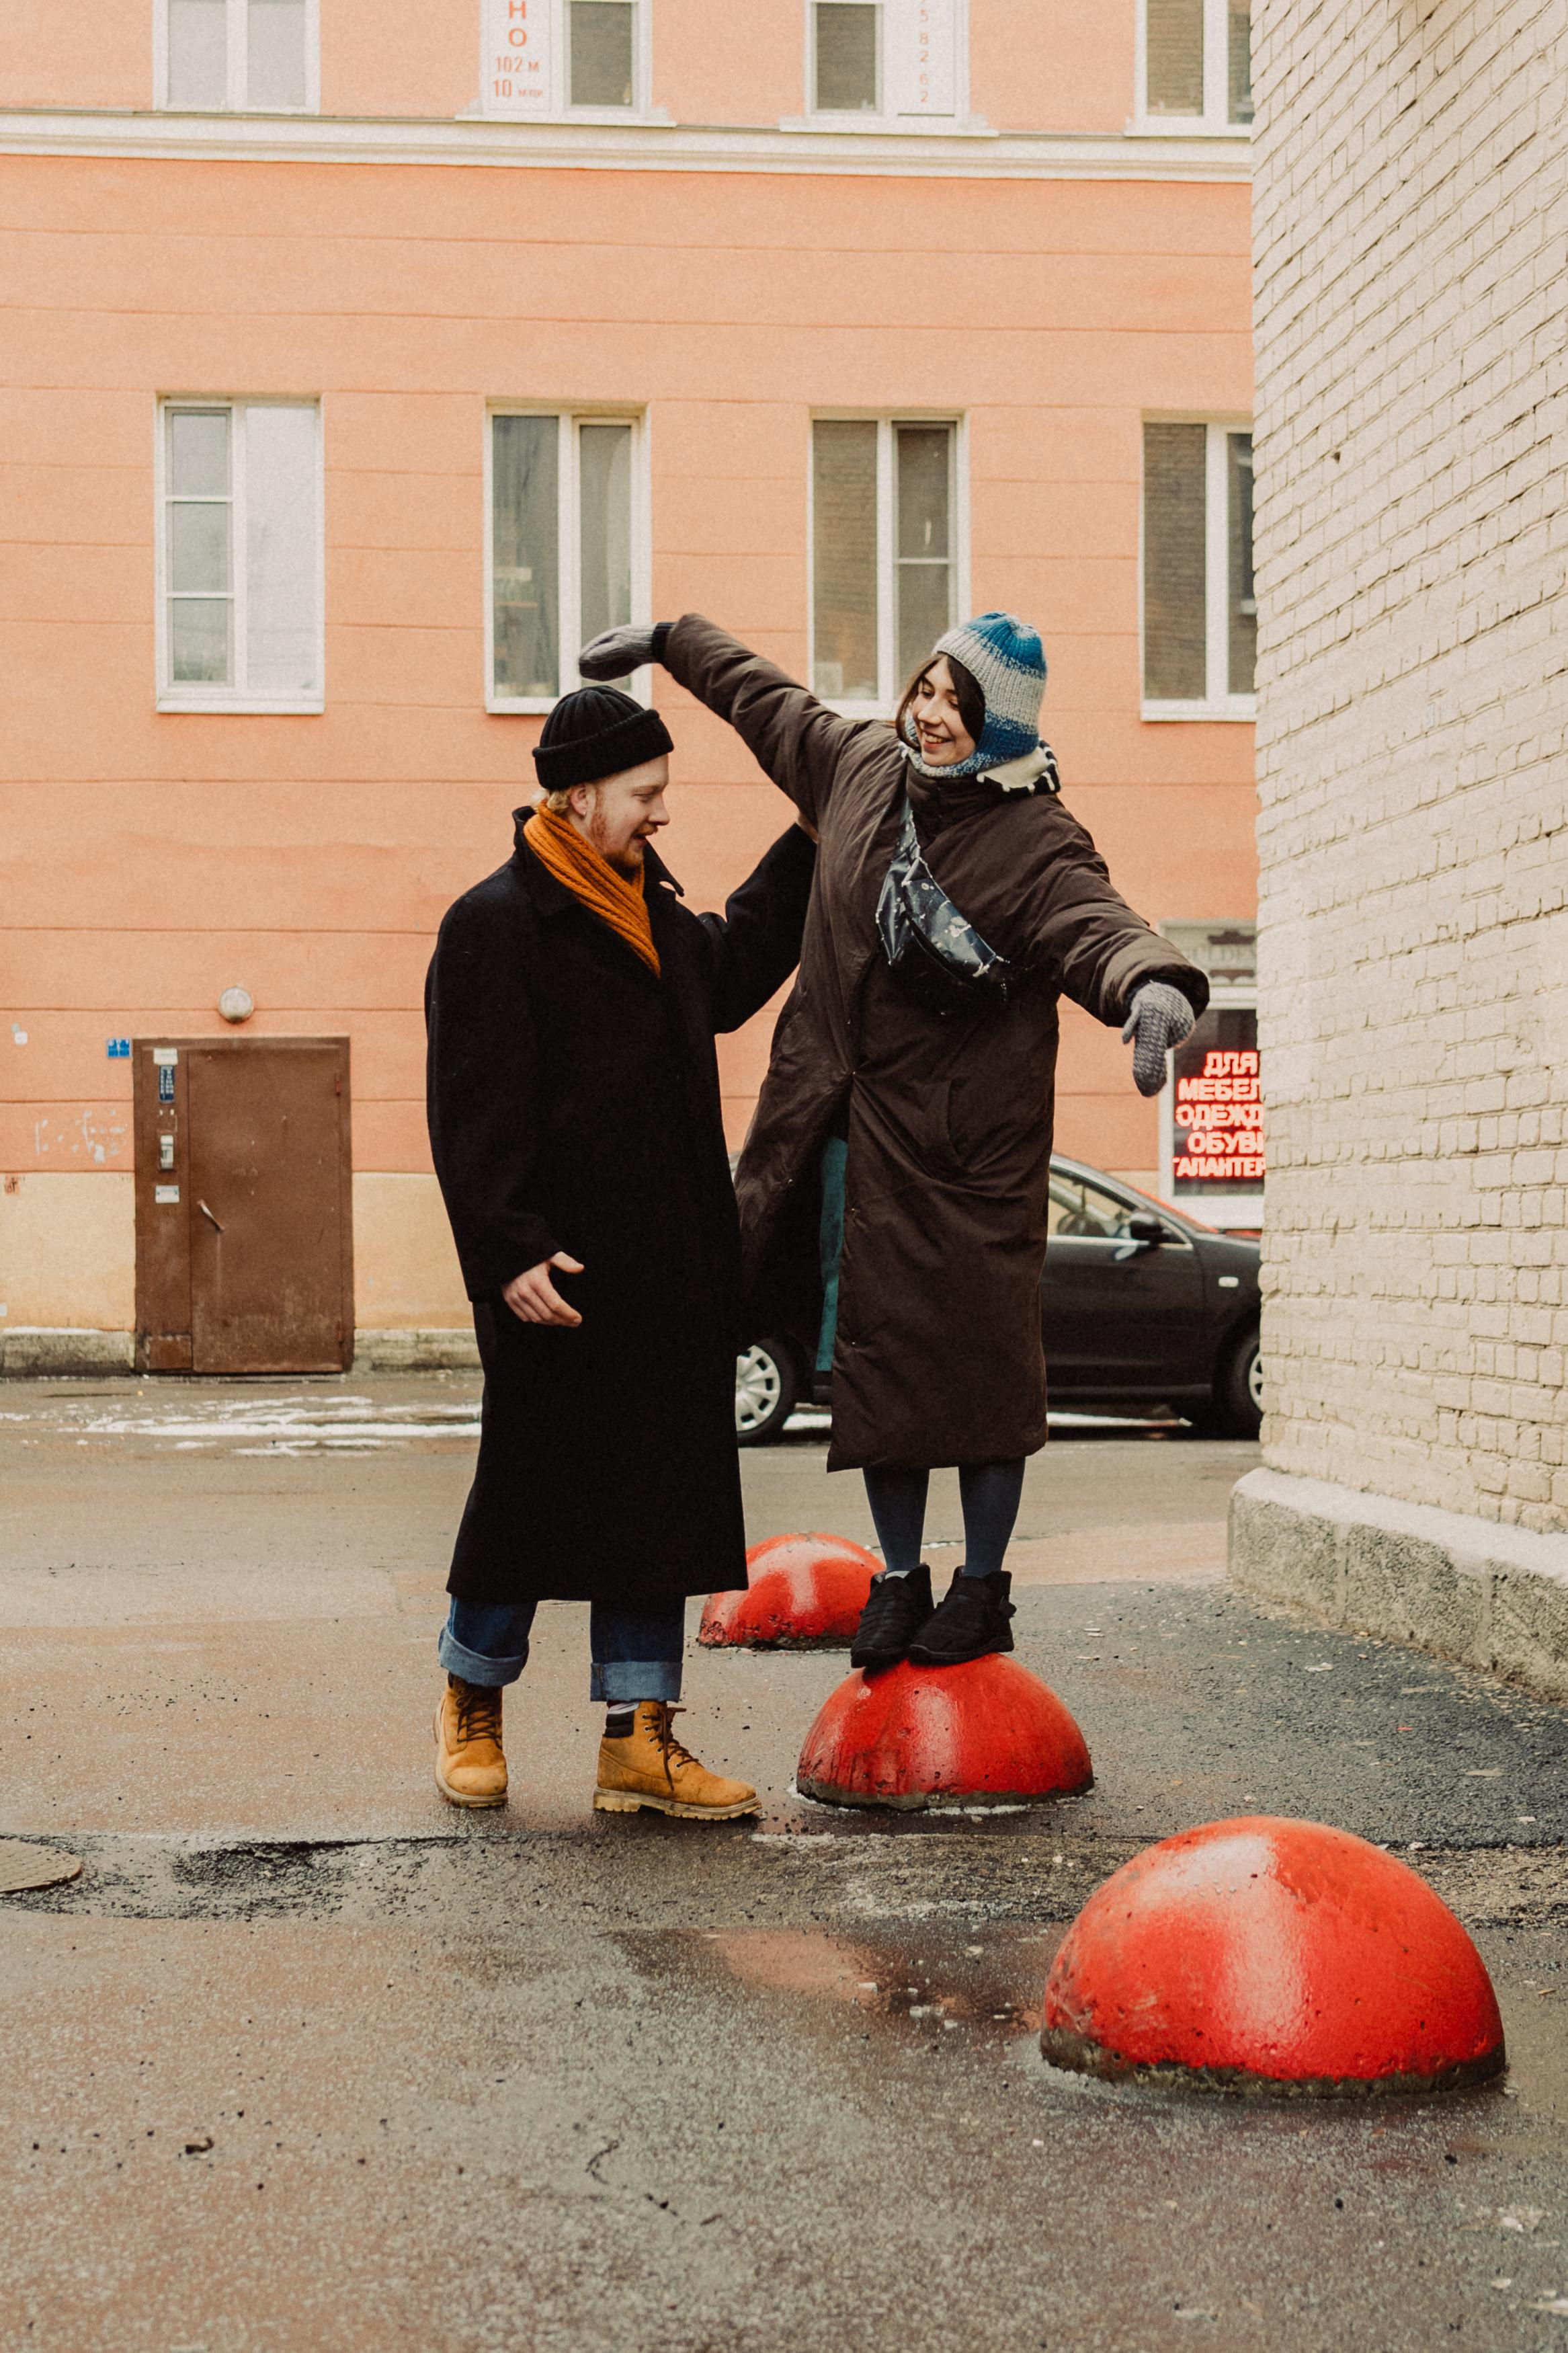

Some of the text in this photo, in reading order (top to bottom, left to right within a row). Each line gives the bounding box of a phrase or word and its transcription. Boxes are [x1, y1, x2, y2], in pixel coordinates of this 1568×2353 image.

[496, 56, 522, 73] 102
[494, 79, 511, 97] 10
[1204, 1051, 1258, 1078] ДЛЯ
[1172, 1156, 1266, 1177] АЛАНТЕР
